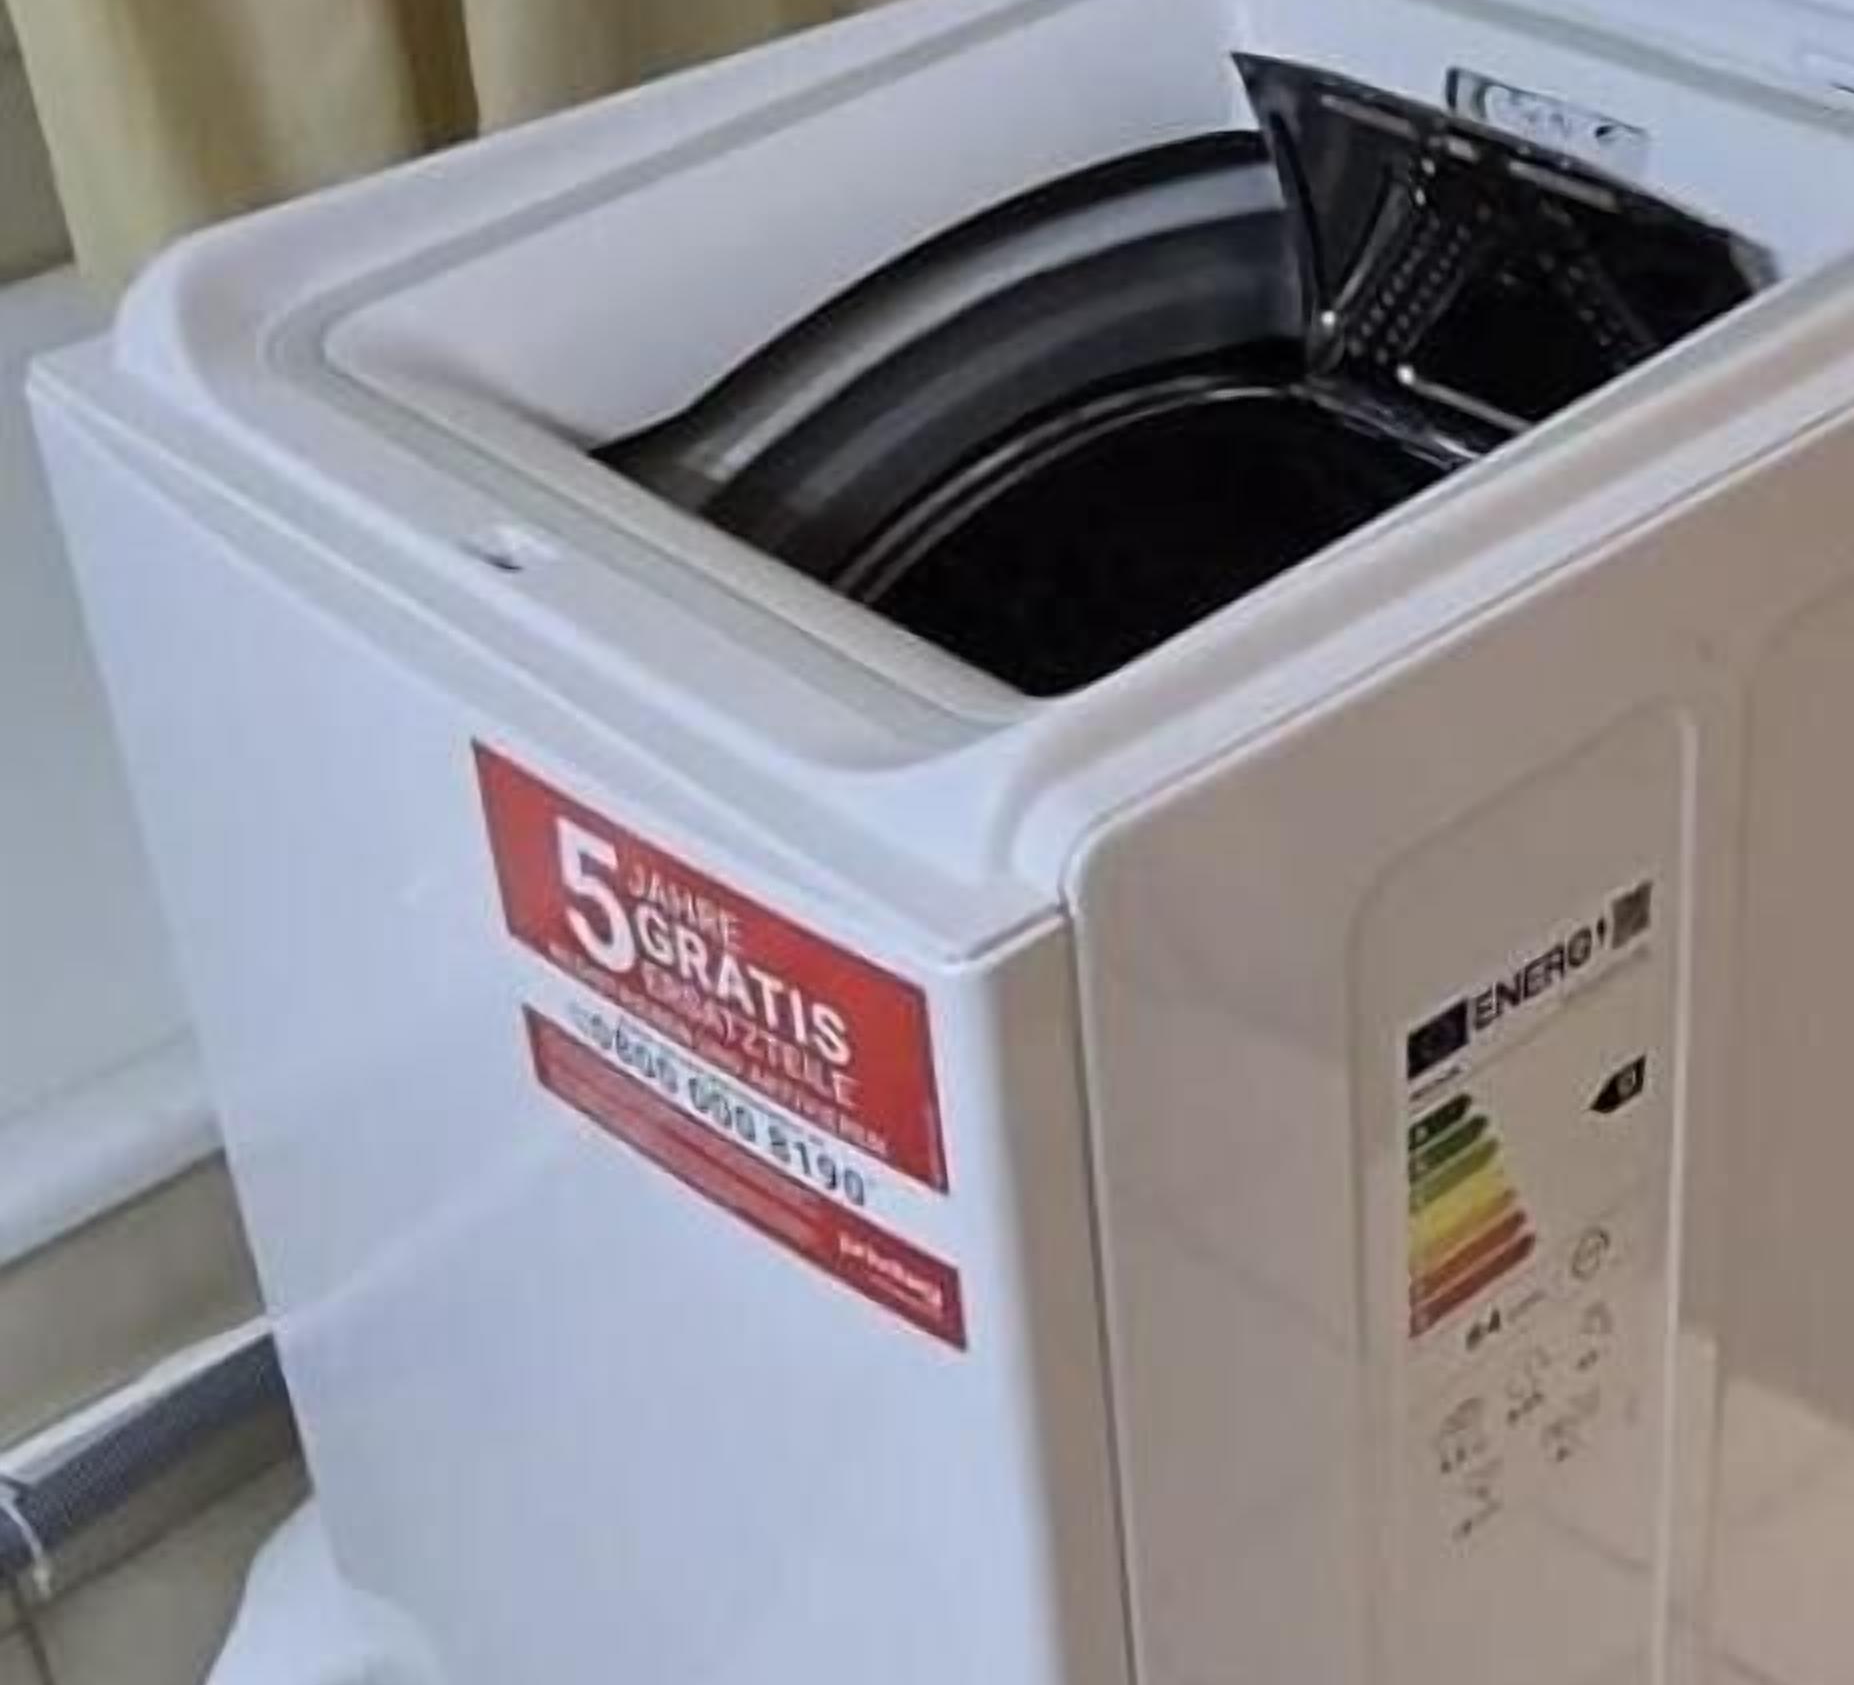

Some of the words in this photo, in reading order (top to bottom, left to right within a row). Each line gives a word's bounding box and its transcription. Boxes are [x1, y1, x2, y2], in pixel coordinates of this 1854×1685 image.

[556, 815, 636, 974] 5
[627, 862, 742, 954] JAHRE
[634, 904, 851, 1066] GRATIS
[1474, 926, 1593, 1031] ENERG
